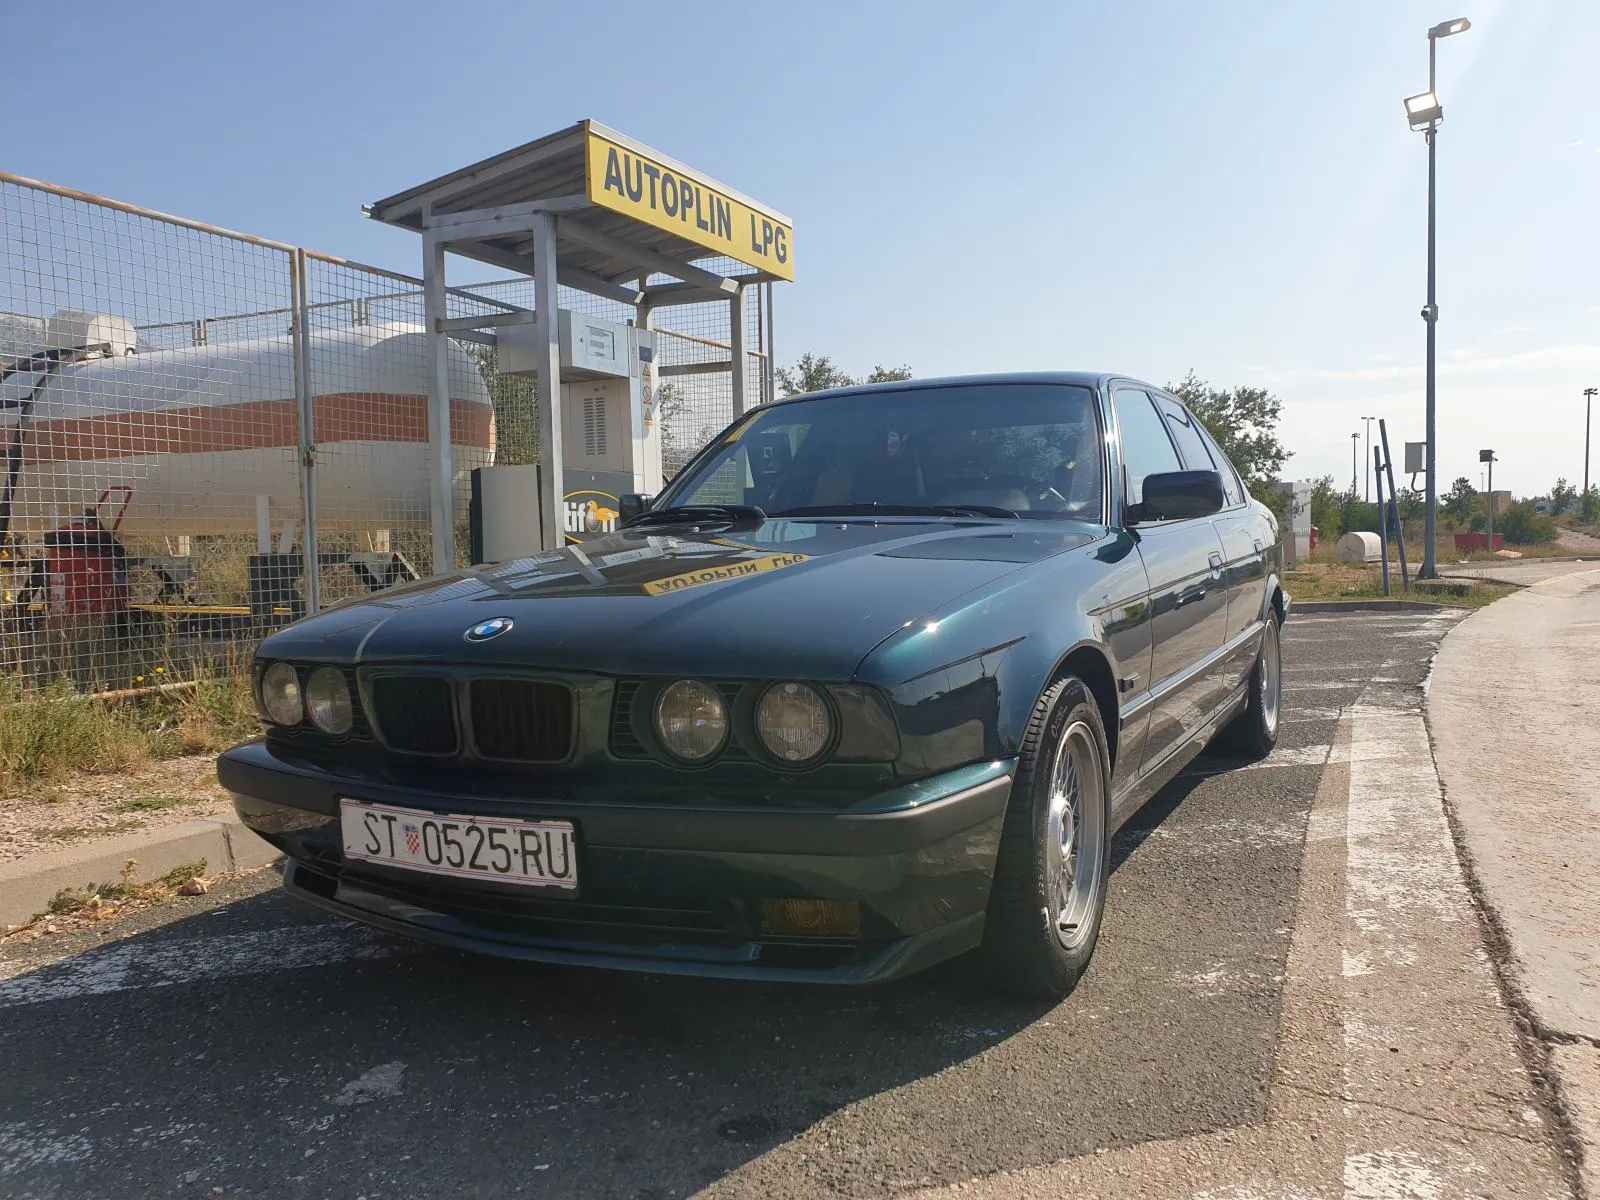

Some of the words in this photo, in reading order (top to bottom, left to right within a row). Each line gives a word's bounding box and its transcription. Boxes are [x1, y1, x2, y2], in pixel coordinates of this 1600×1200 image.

[604, 147, 732, 241] AUTOPLIN
[750, 213, 788, 264] LPG
[363, 811, 398, 858] ST
